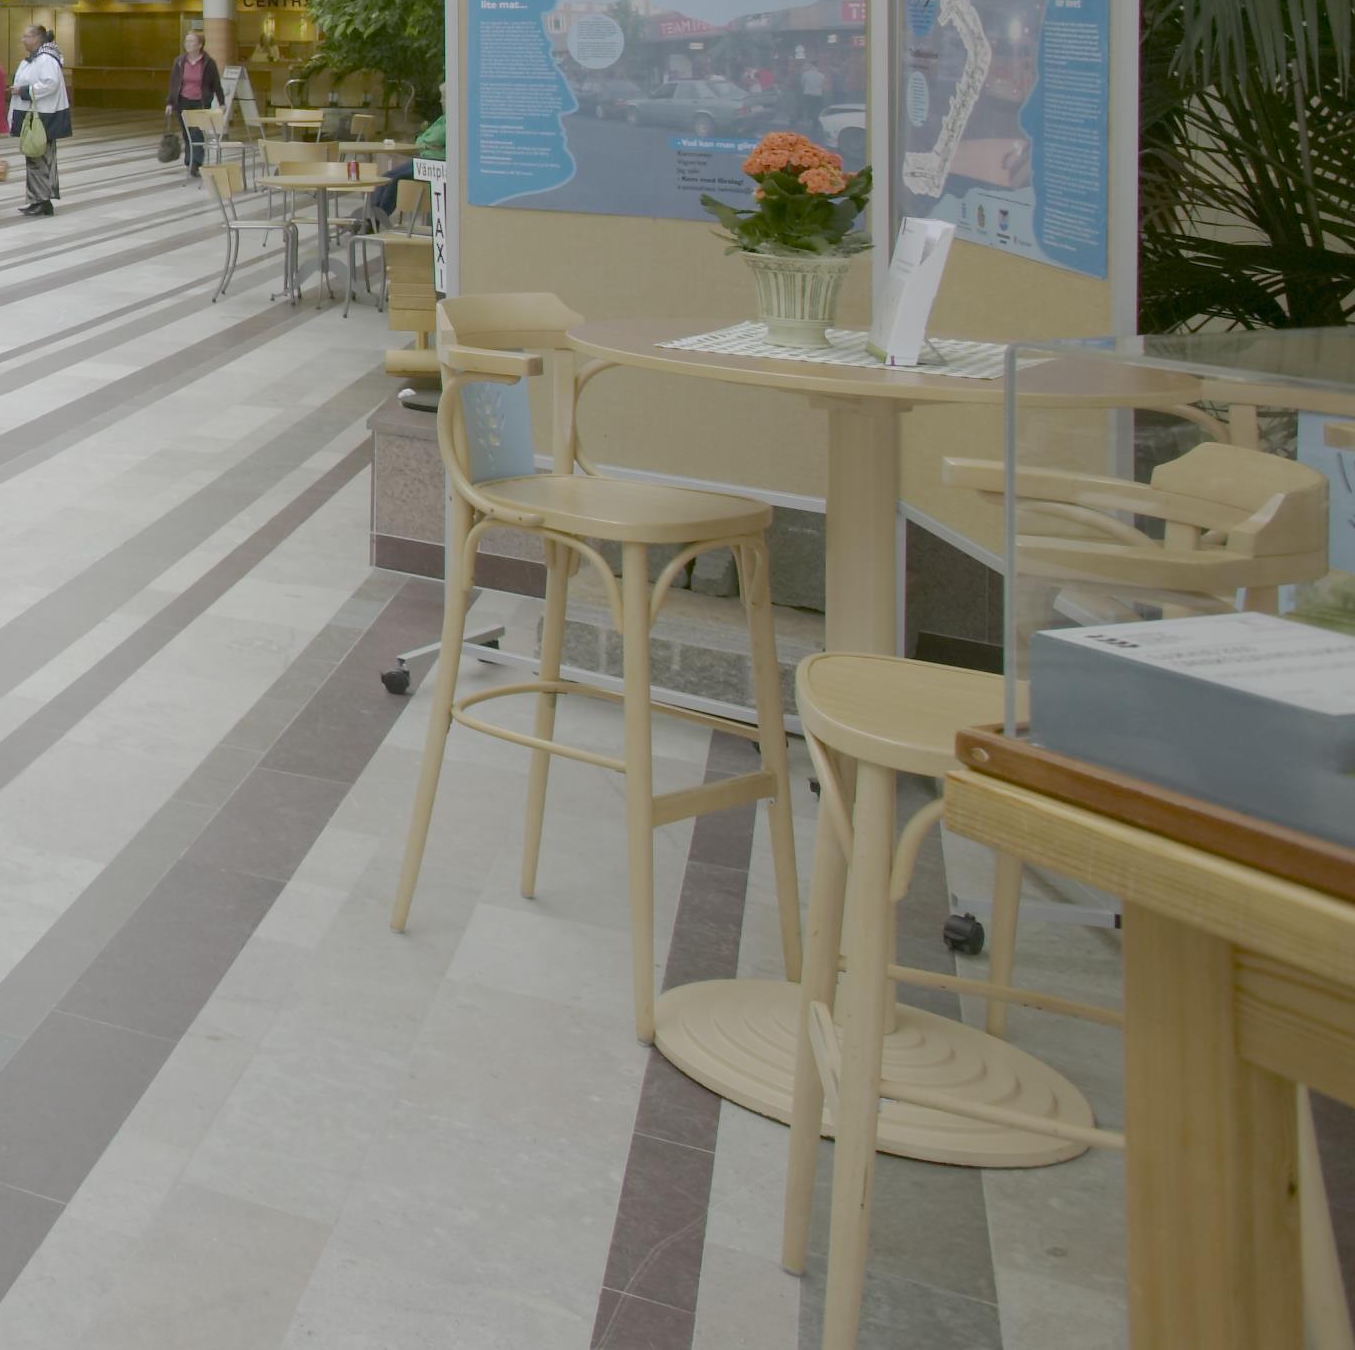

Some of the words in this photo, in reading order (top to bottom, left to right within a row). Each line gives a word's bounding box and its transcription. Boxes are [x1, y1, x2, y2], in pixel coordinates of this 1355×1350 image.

[480, 0, 497, 9] lite
[416, 161, 447, 182] Väntpl
[434, 192, 445, 289] TAXI
